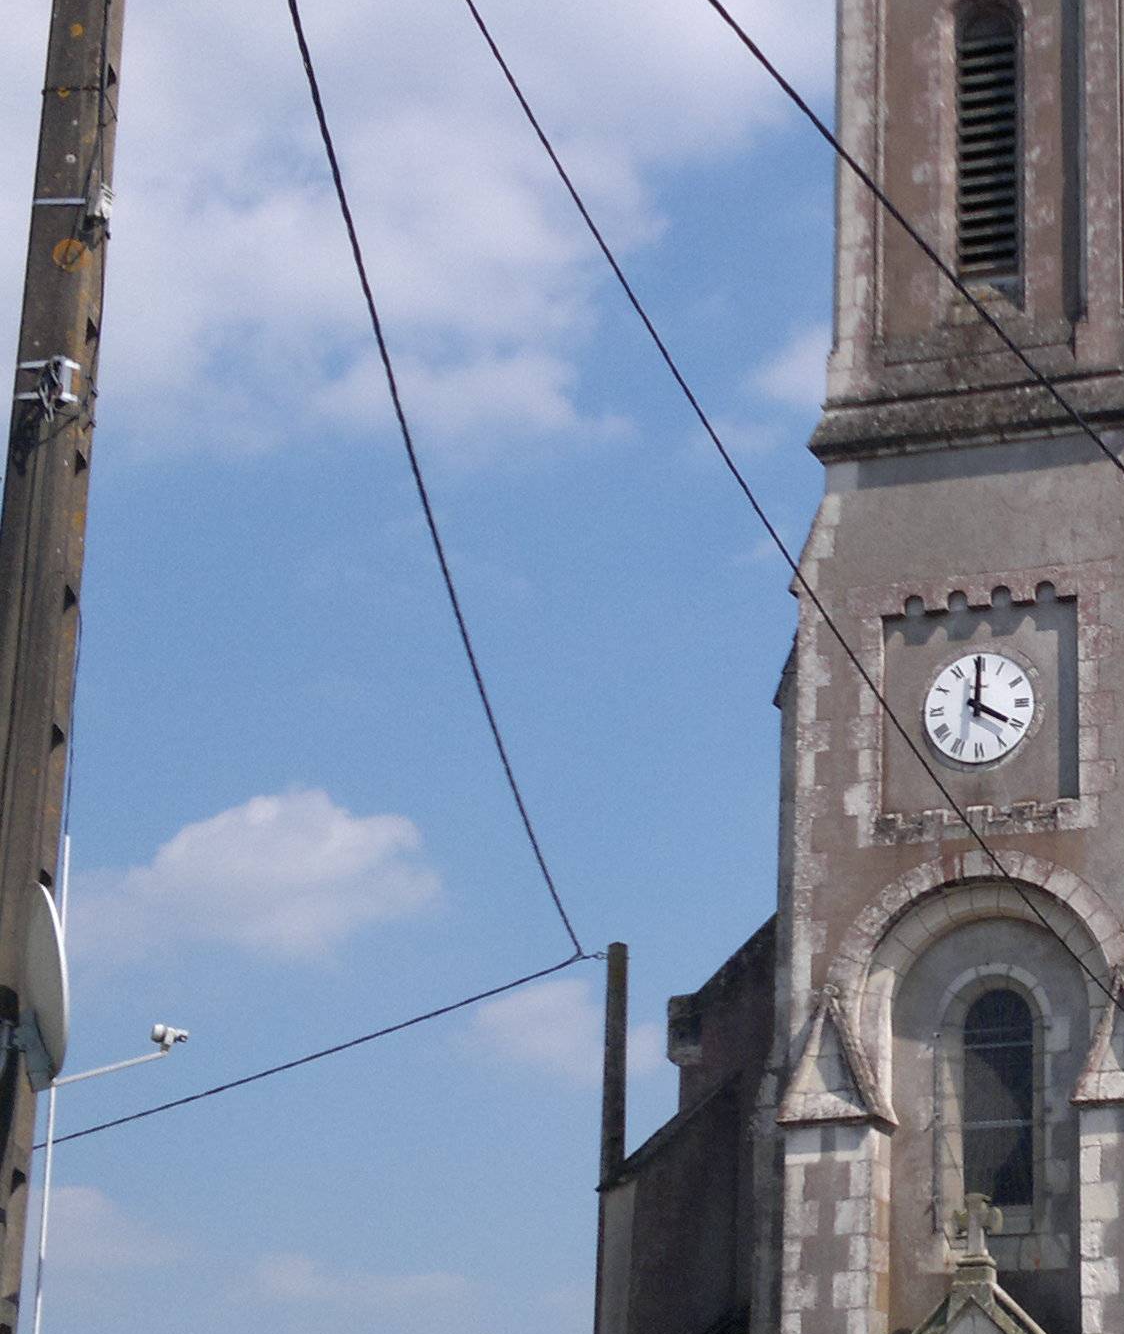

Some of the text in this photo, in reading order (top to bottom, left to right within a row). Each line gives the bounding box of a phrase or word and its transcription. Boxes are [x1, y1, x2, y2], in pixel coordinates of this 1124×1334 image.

[995, 661, 1005, 676] I
[1008, 675, 1023, 688] II
[935, 685, 950, 696] X
[1014, 697, 1029, 708] III
[930, 706, 944, 717] IX
